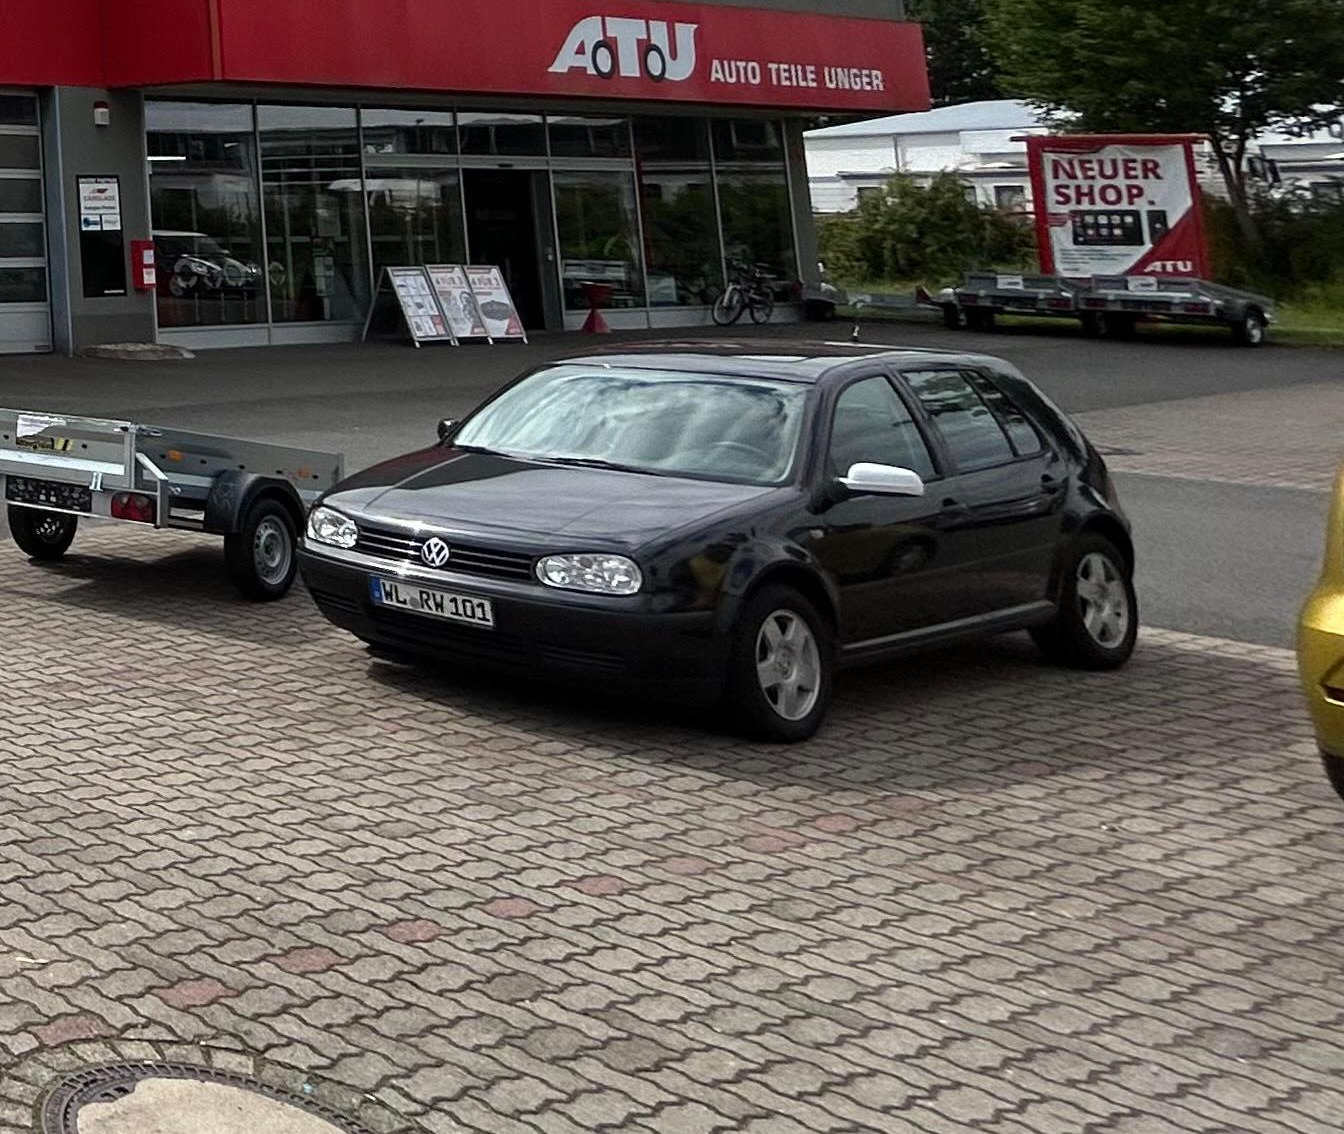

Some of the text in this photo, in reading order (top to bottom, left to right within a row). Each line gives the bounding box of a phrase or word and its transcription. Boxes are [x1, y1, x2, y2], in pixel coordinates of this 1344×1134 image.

[710, 59, 885, 92] AUTO TEILE UNGER
[1051, 158, 1163, 180] NEUER
[1054, 183, 1156, 206] SHOP.
[1144, 260, 1192, 273] ATU
[381, 581, 491, 622] WL RW 101
